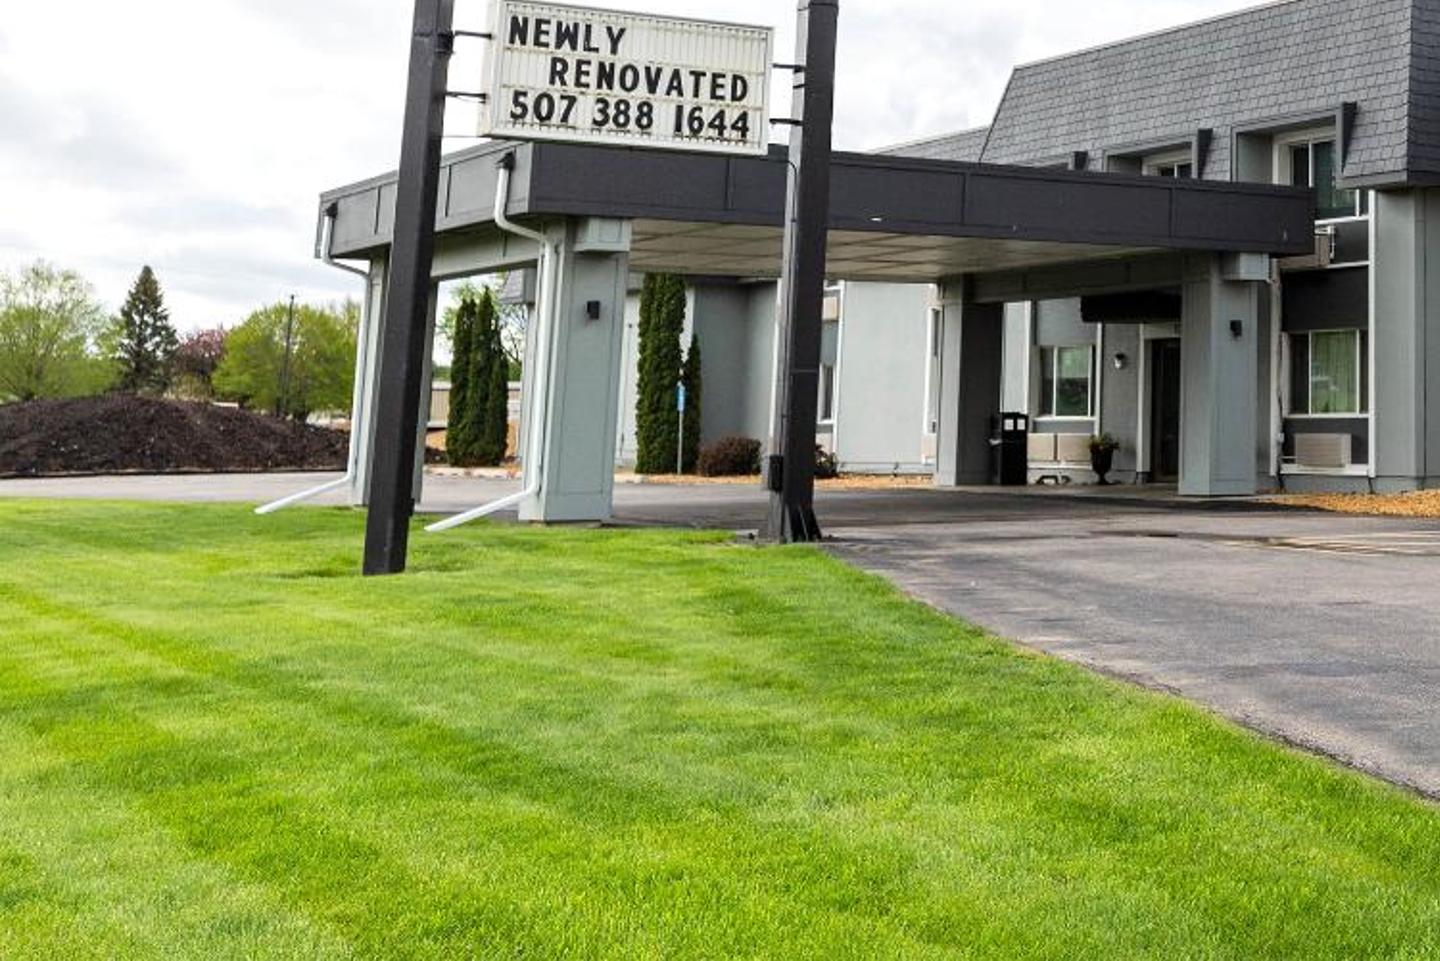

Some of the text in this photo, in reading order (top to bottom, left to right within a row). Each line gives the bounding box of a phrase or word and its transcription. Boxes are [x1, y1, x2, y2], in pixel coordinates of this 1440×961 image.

[508, 15, 627, 56] NEWLY
[549, 56, 749, 103] RENOVATED
[510, 90, 750, 139] 507 388 1644
